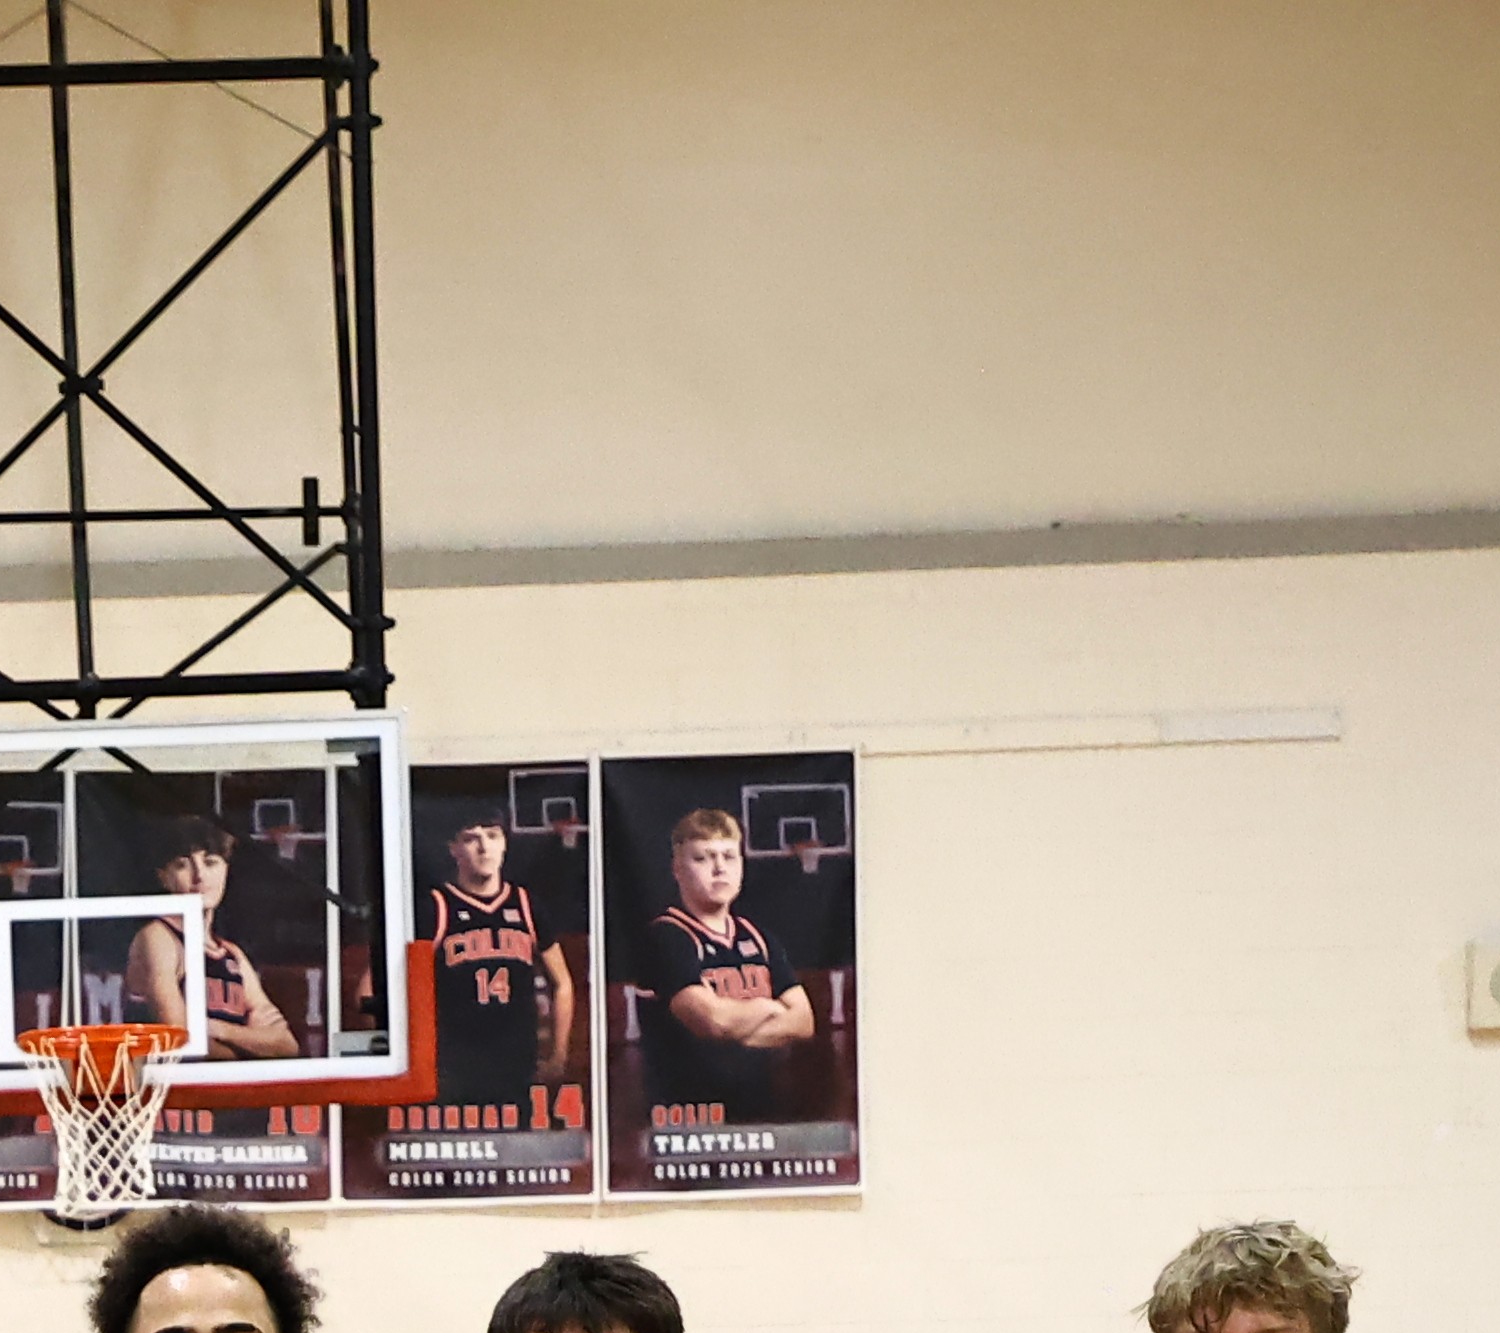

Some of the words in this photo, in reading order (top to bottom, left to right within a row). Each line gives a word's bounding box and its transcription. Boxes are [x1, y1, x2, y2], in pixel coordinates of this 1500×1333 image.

[475, 968, 511, 1005] 14
[529, 1084, 585, 1130] 14
[389, 1141, 498, 1161] MORRELL
[654, 1132, 776, 1154] TRATTLER
[388, 1171, 445, 1187] COLON
[506, 1169, 571, 1184] SENIOR
[654, 1163, 711, 1180] COLON
[772, 1159, 837, 1175] SENIOR
[244, 1174, 309, 1190] SENIOR
